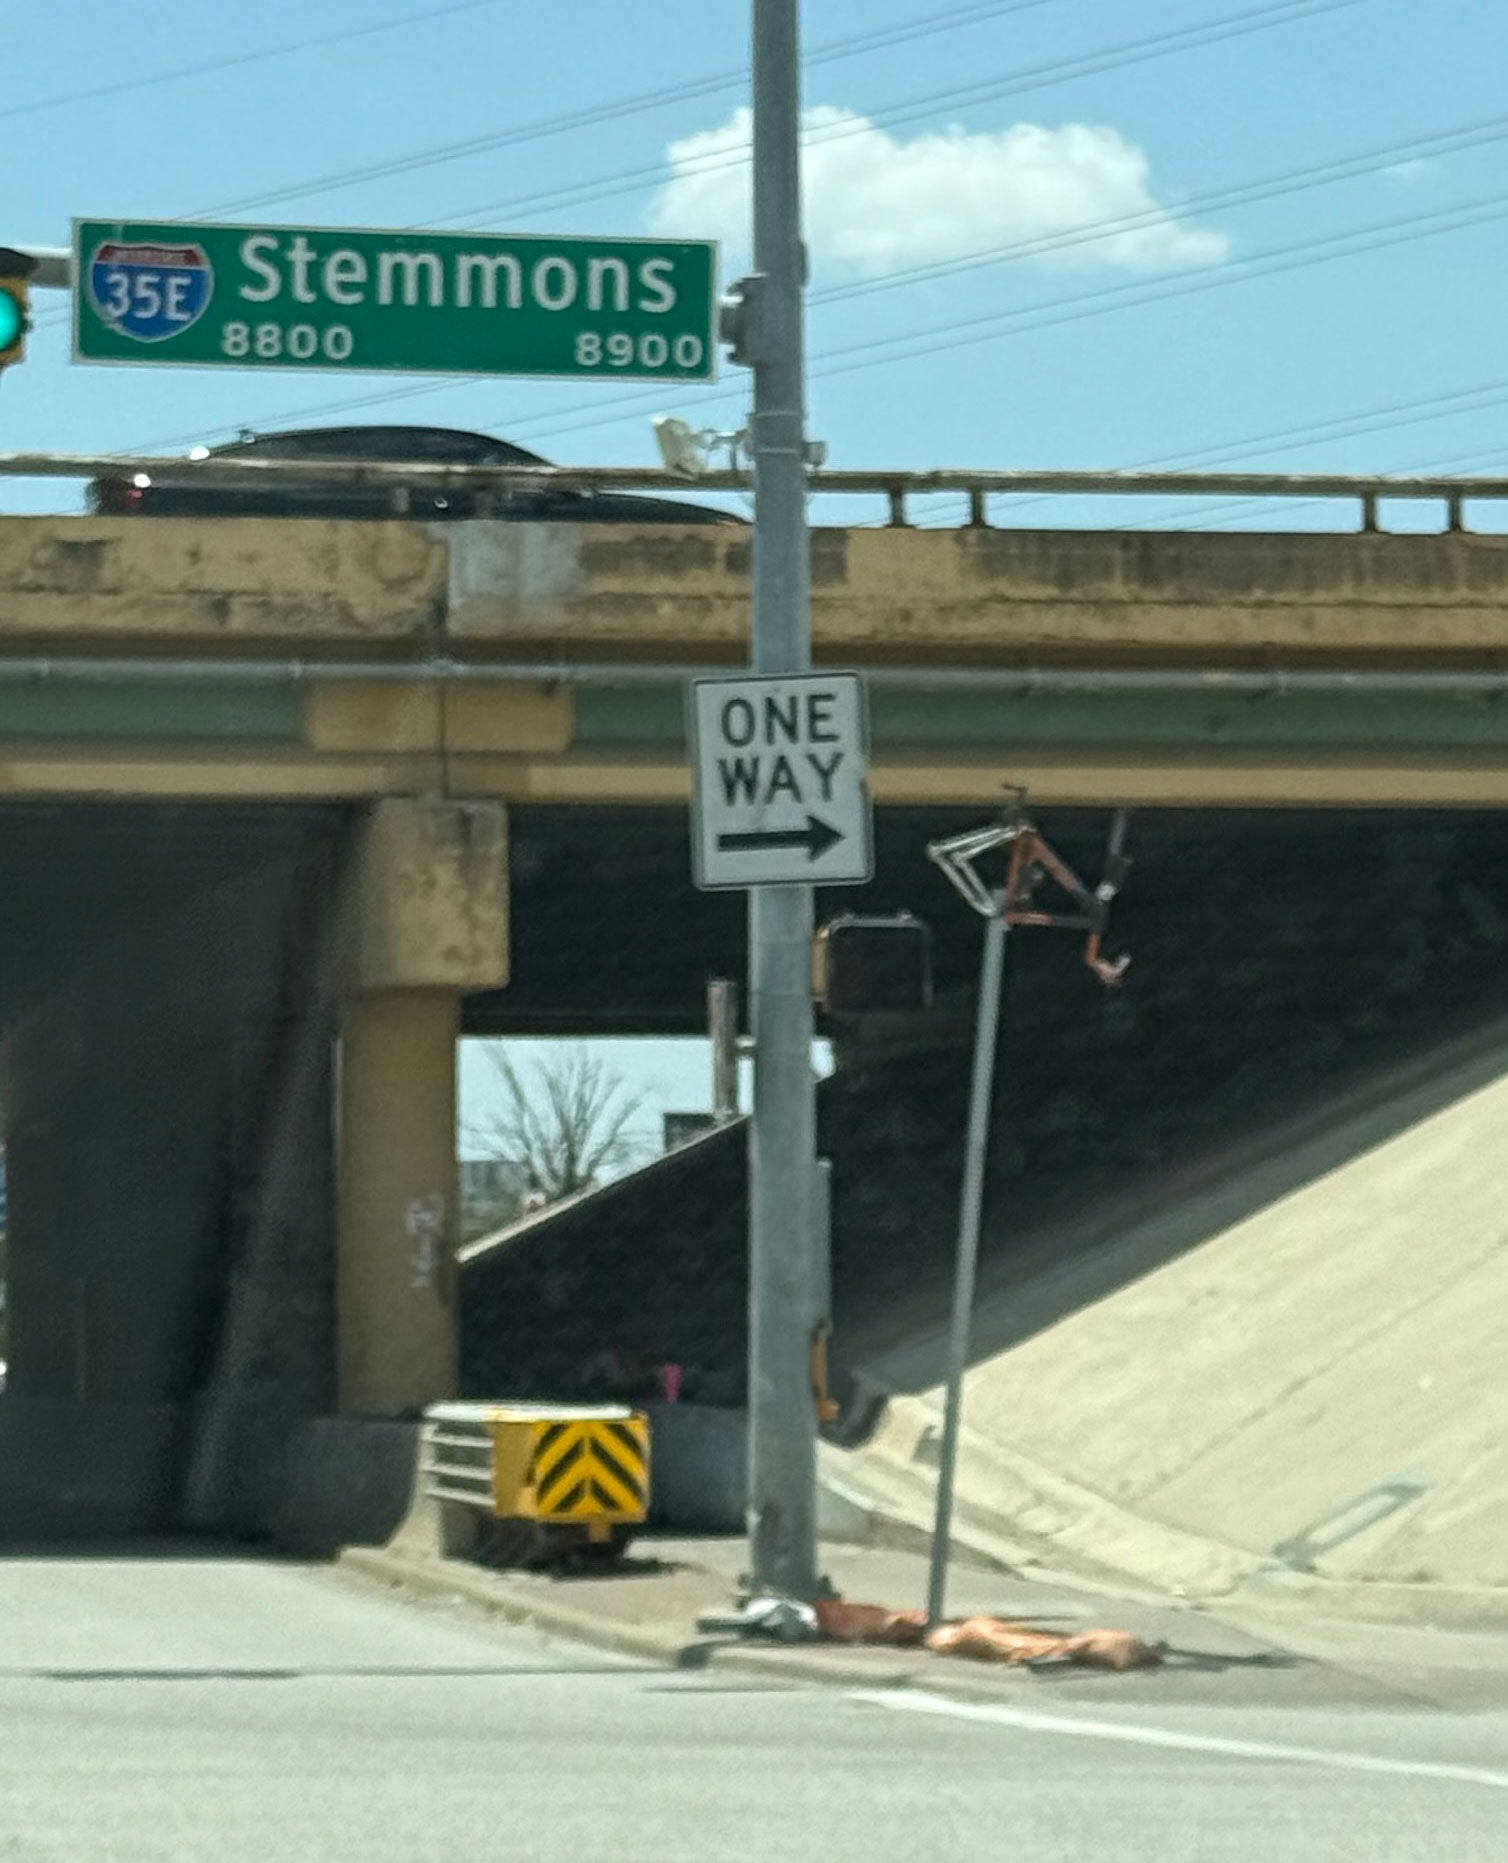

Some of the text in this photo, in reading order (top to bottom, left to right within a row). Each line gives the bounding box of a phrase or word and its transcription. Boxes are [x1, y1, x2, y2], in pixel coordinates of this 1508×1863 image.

[106, 272, 192, 321] 35E
[239, 234, 677, 313] Stemmons
[221, 321, 354, 360] 8800
[574, 331, 704, 368] 8900
[721, 693, 840, 748] ONE
[717, 752, 845, 807] WAY
